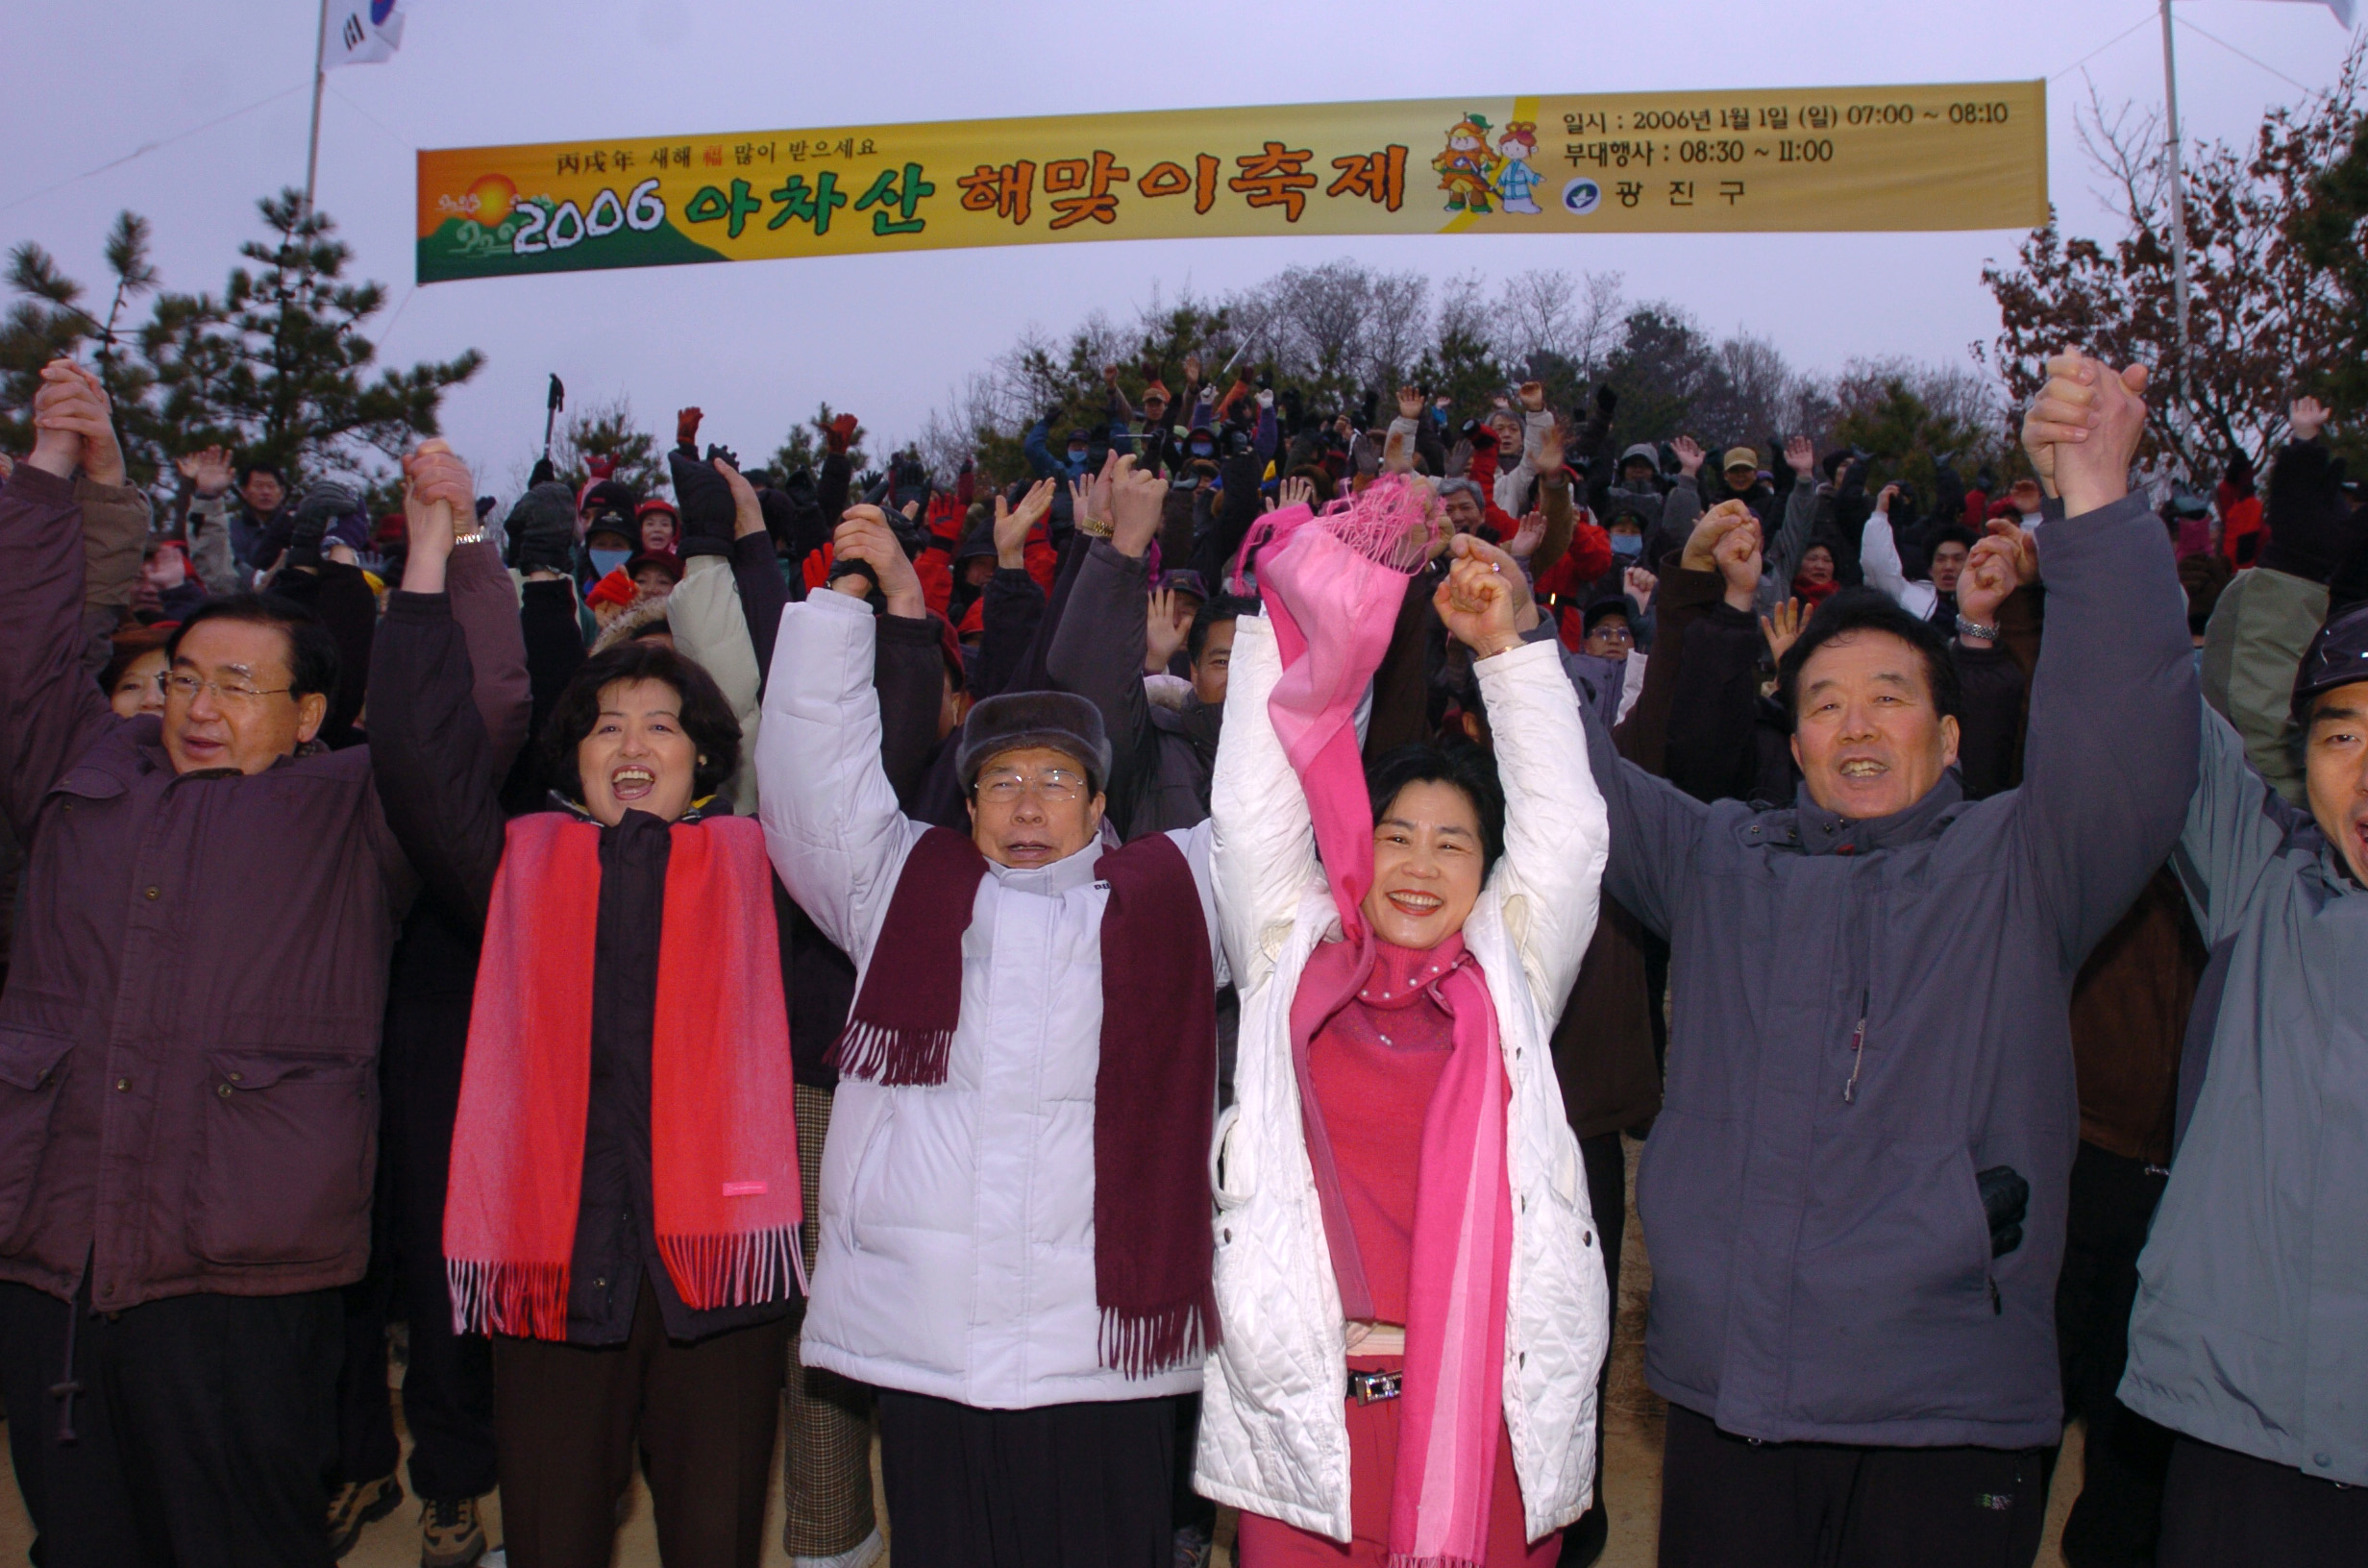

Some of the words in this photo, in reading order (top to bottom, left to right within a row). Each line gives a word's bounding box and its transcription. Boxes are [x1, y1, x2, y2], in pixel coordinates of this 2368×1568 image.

[1563, 111, 1607, 135] 일시
[1633, 109, 1712, 132] 2006년
[1720, 107, 1750, 131] 1월
[1758, 106, 1788, 130] 1일
[1799, 105, 1838, 129] (일)
[1847, 104, 1914, 125] 07:00
[1948, 103, 2009, 124] 08:10
[556, 149, 635, 176] 丙戌年
[650, 145, 691, 170] 새해
[703, 144, 723, 167] 福
[734, 141, 776, 166] 많이
[788, 137, 878, 162] 받으세요
[1565, 140, 1654, 167] 부대행사
[1680, 140, 1744, 162] 08:30
[1779, 139, 1833, 162] 11:00
[513, 180, 665, 254] 2006
[685, 162, 935, 237] 아차산
[957, 141, 1409, 230] 해맞이축제
